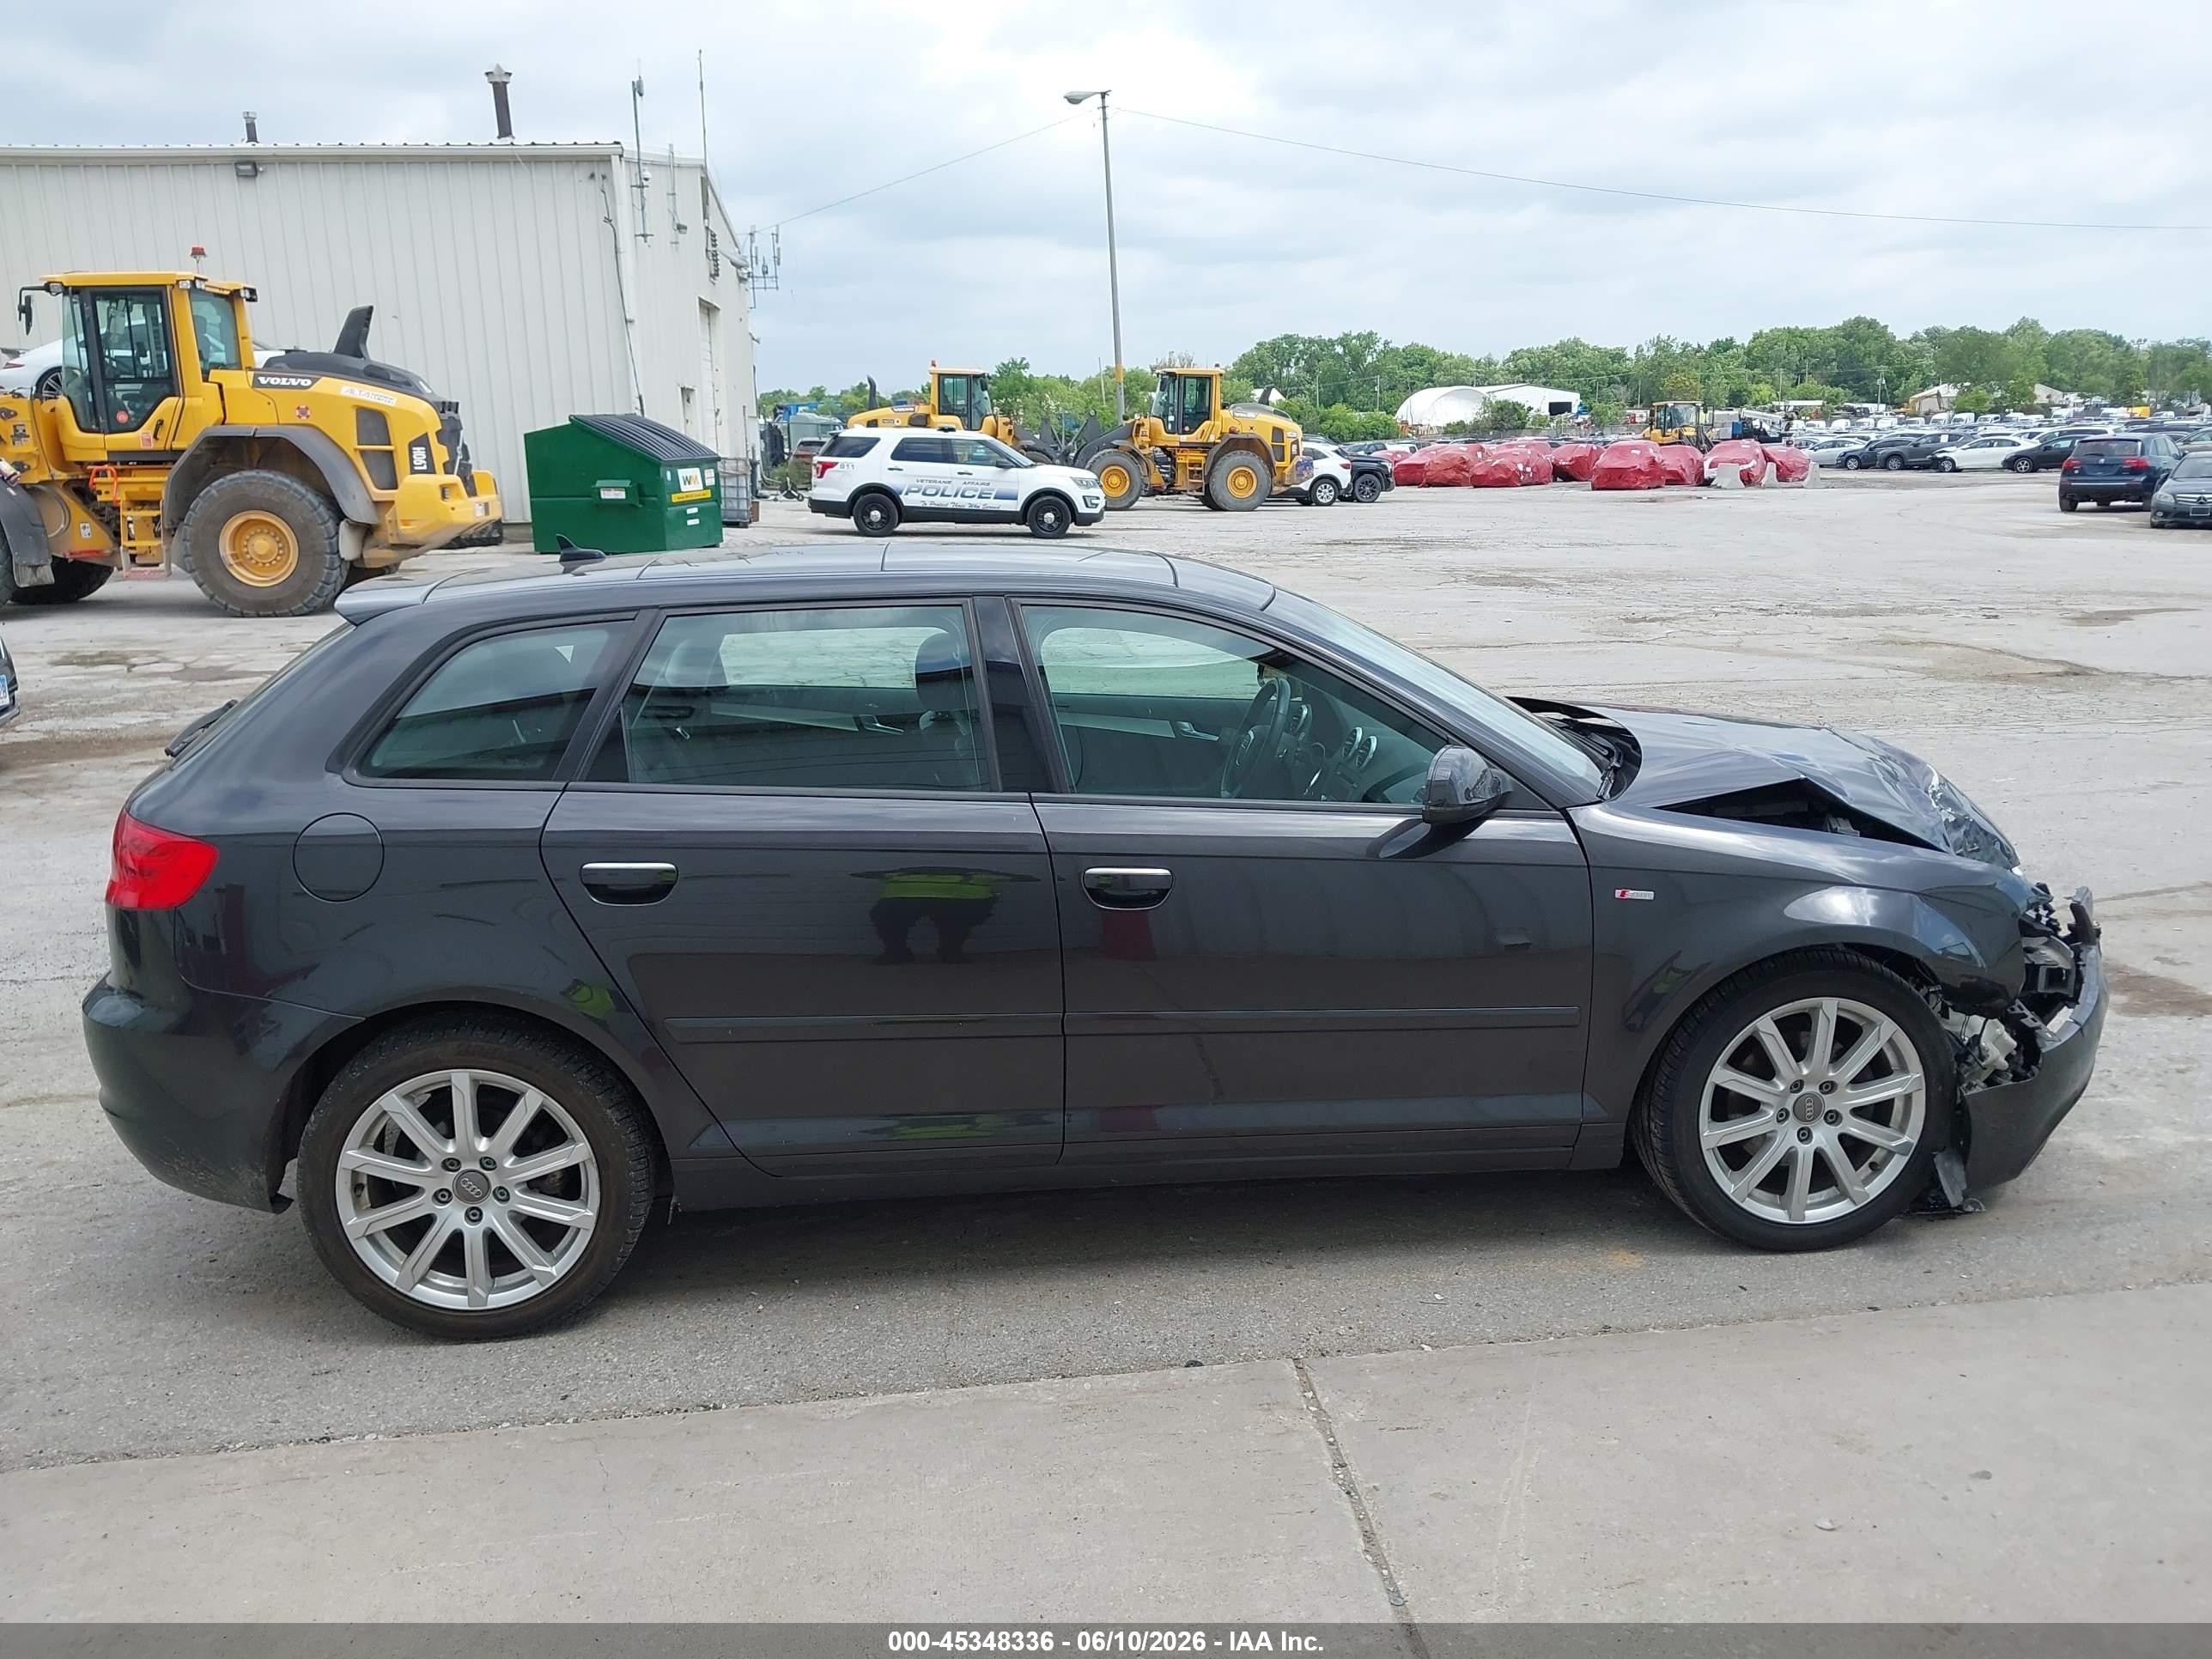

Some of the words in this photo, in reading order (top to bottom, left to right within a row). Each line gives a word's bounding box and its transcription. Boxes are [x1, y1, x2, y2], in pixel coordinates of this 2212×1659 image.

[258, 376, 312, 386] VOLVO
[412, 447, 428, 471] L90H
[683, 475, 699, 486] WM
[903, 483, 996, 499] POLICE
